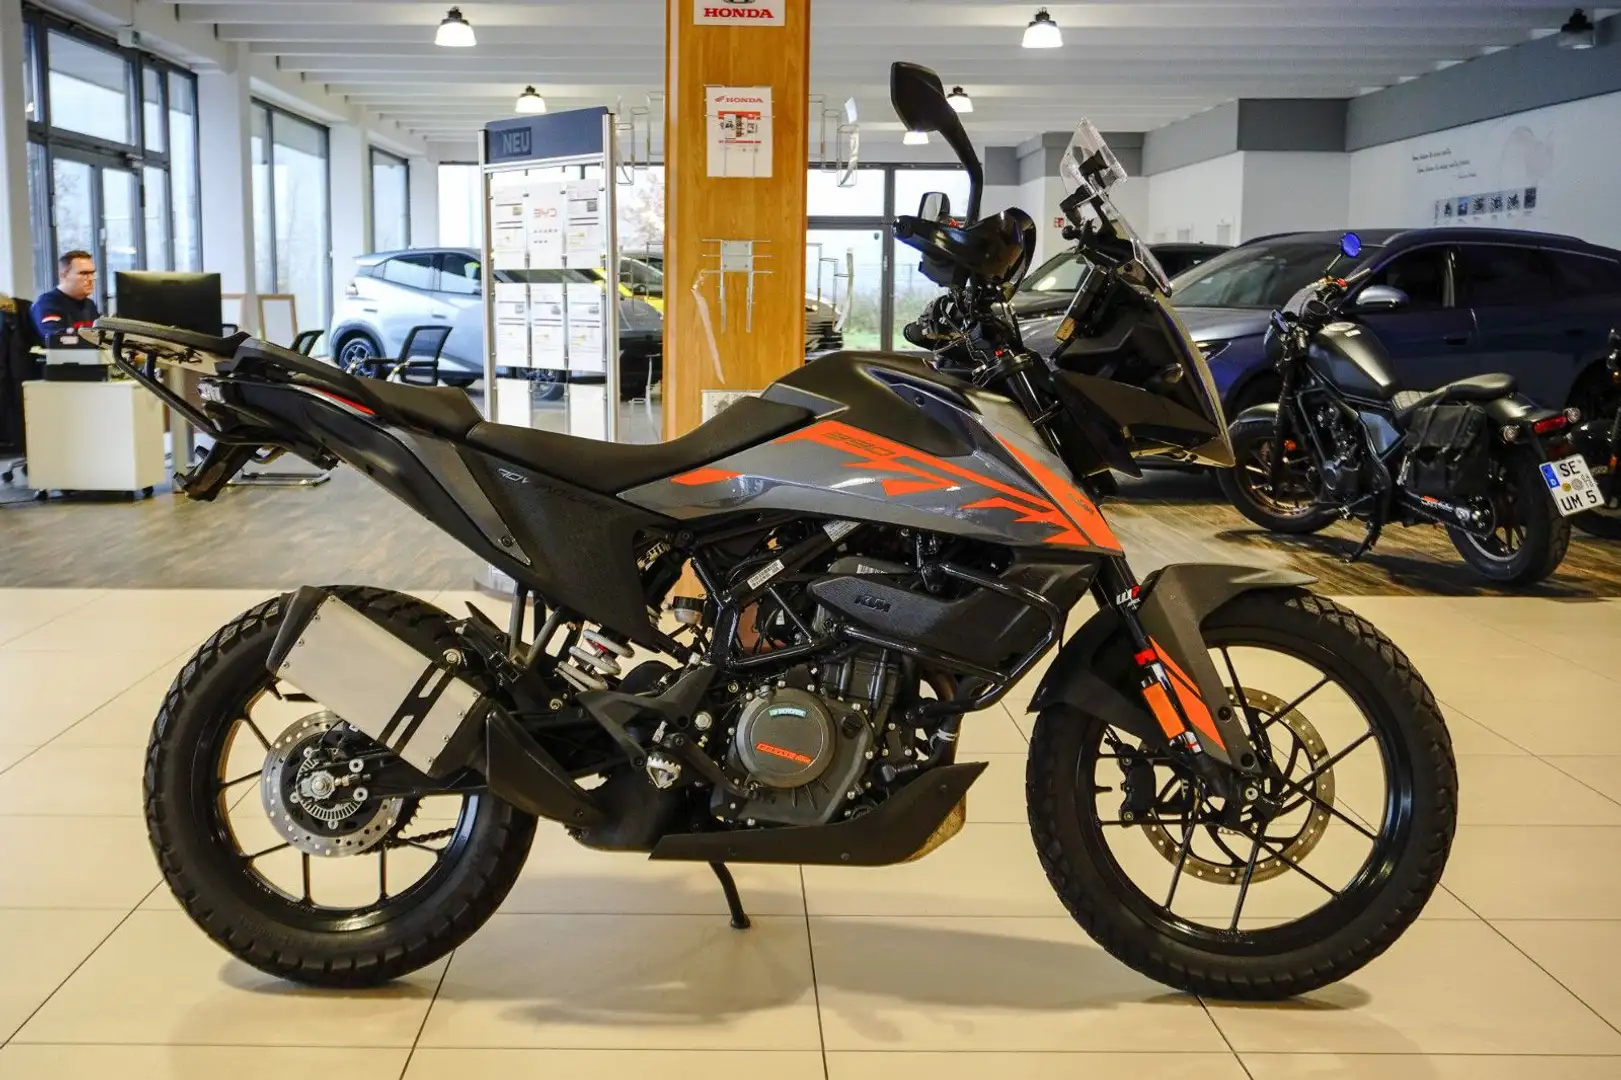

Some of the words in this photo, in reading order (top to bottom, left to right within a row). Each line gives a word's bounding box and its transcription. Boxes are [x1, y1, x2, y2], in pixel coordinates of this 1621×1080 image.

[703, 7, 775, 19] HONDA
[502, 131, 530, 155] NEU
[1559, 460, 1580, 477] SE
[1560, 494, 1584, 511] UM
[1585, 489, 1598, 504] 5
[854, 595, 892, 612] KTM
